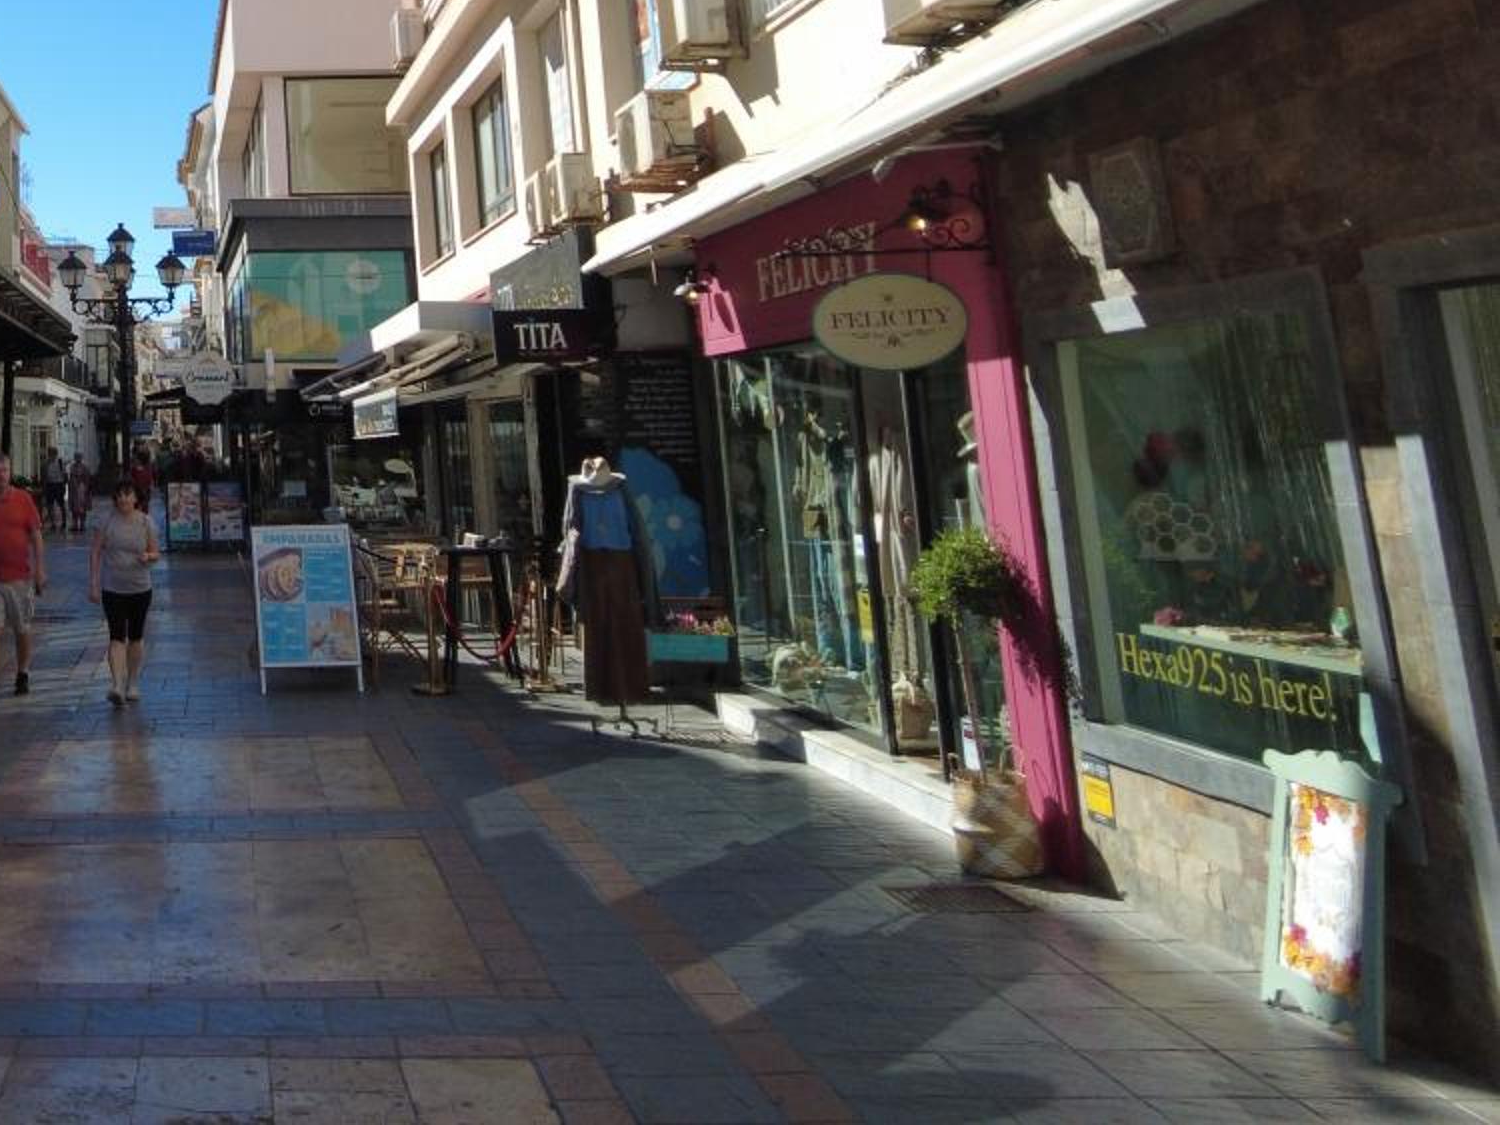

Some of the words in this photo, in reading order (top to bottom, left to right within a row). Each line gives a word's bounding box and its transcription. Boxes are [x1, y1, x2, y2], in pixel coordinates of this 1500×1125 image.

[756, 221, 876, 303] FELICITY
[513, 322, 569, 350] TITA
[829, 306, 950, 330] FELICITY
[1116, 632, 1227, 697] Hexa925
[1229, 656, 1254, 705] is
[1253, 658, 1339, 722] here!
